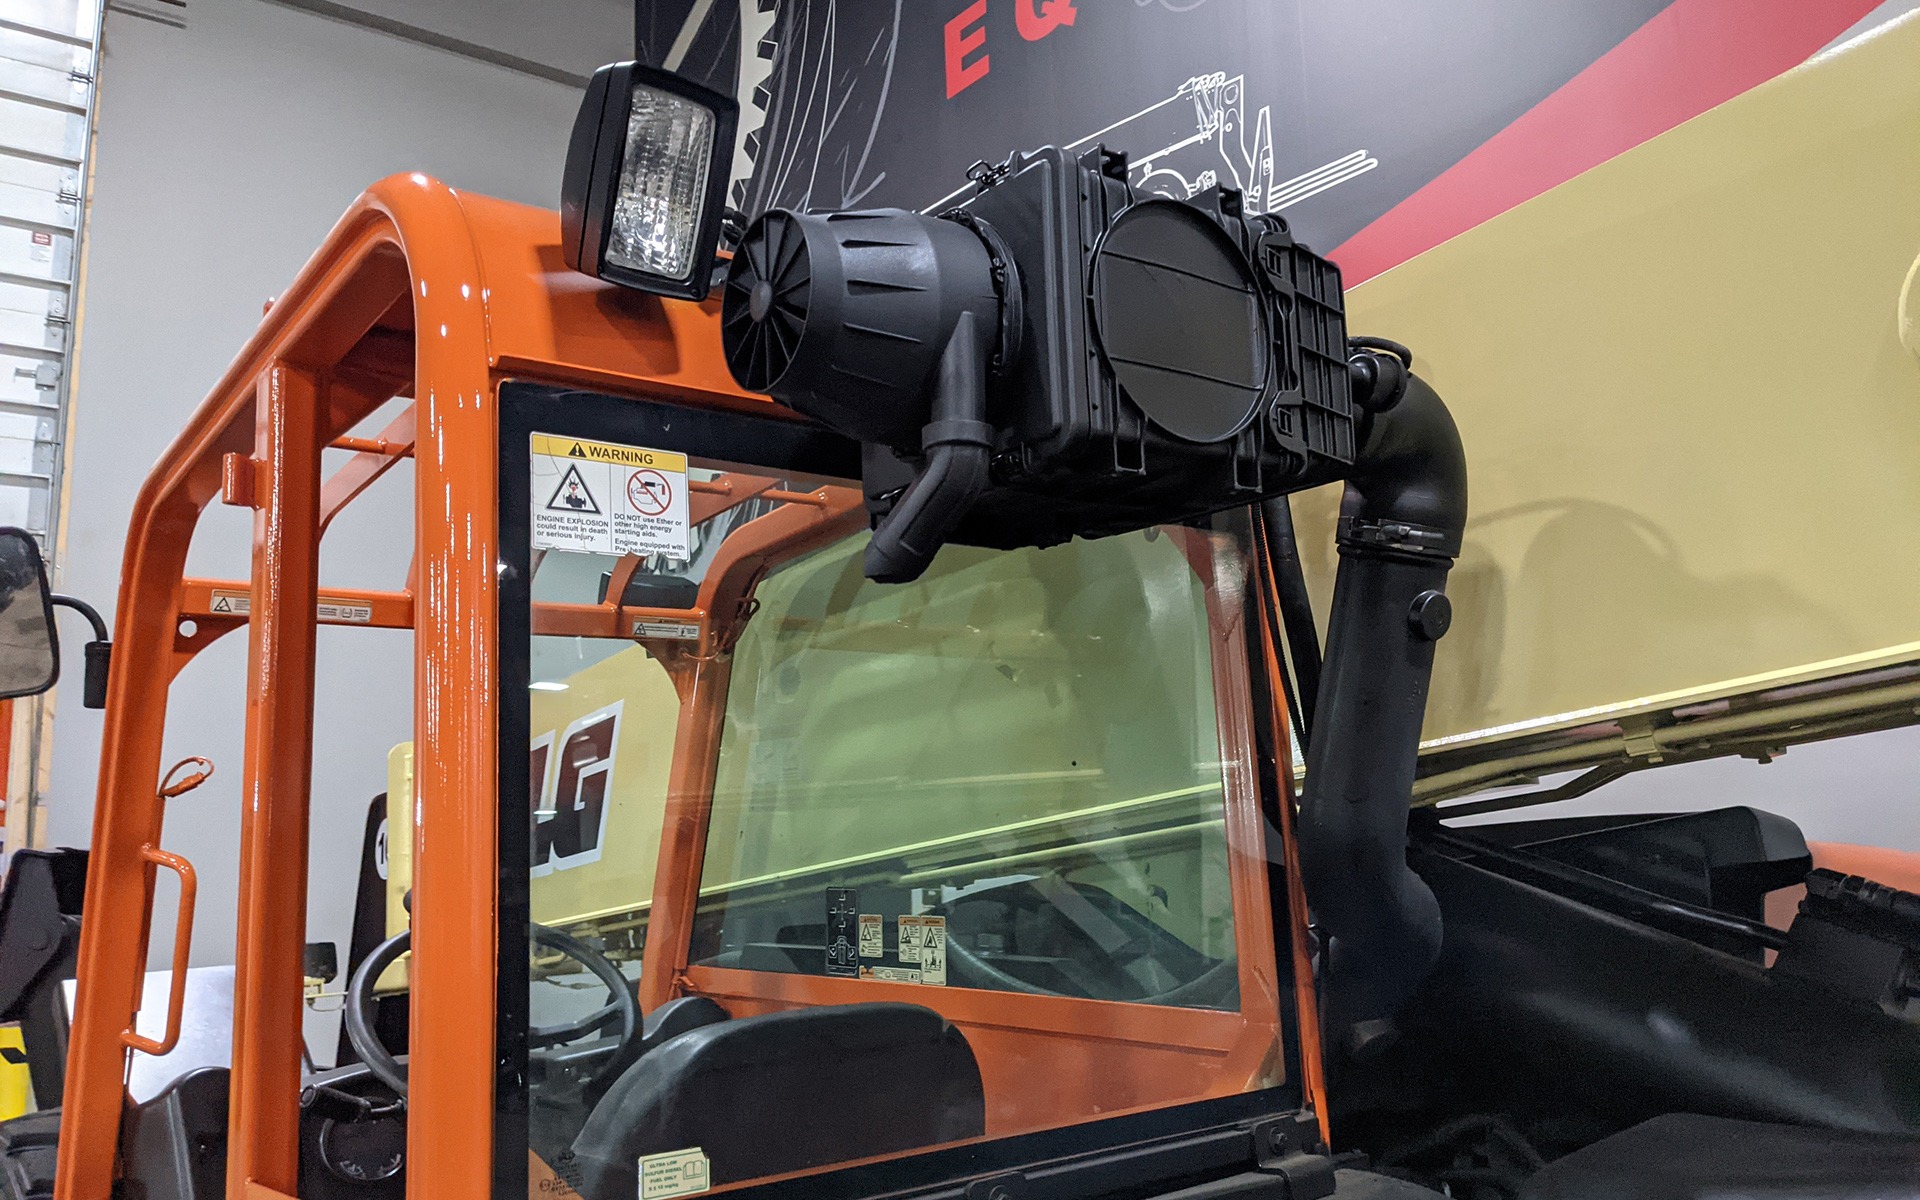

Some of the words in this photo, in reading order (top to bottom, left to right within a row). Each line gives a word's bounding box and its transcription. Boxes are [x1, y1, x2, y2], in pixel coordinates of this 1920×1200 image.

[589, 445, 654, 465] WARNING
[536, 514, 565, 523] ENGINE
[567, 517, 609, 528] EXPLOSION
[626, 514, 641, 522] NOT
[656, 517, 674, 526] Ether
[588, 527, 608, 535] death
[614, 528, 640, 537] starting
[633, 522, 649, 531] high
[649, 525, 672, 534] energy
[546, 531, 573, 539] serious
[574, 532, 596, 542] injury.
[614, 537, 639, 547] Engine
[639, 541, 671, 551] equipped
[671, 543, 686, 551] with
